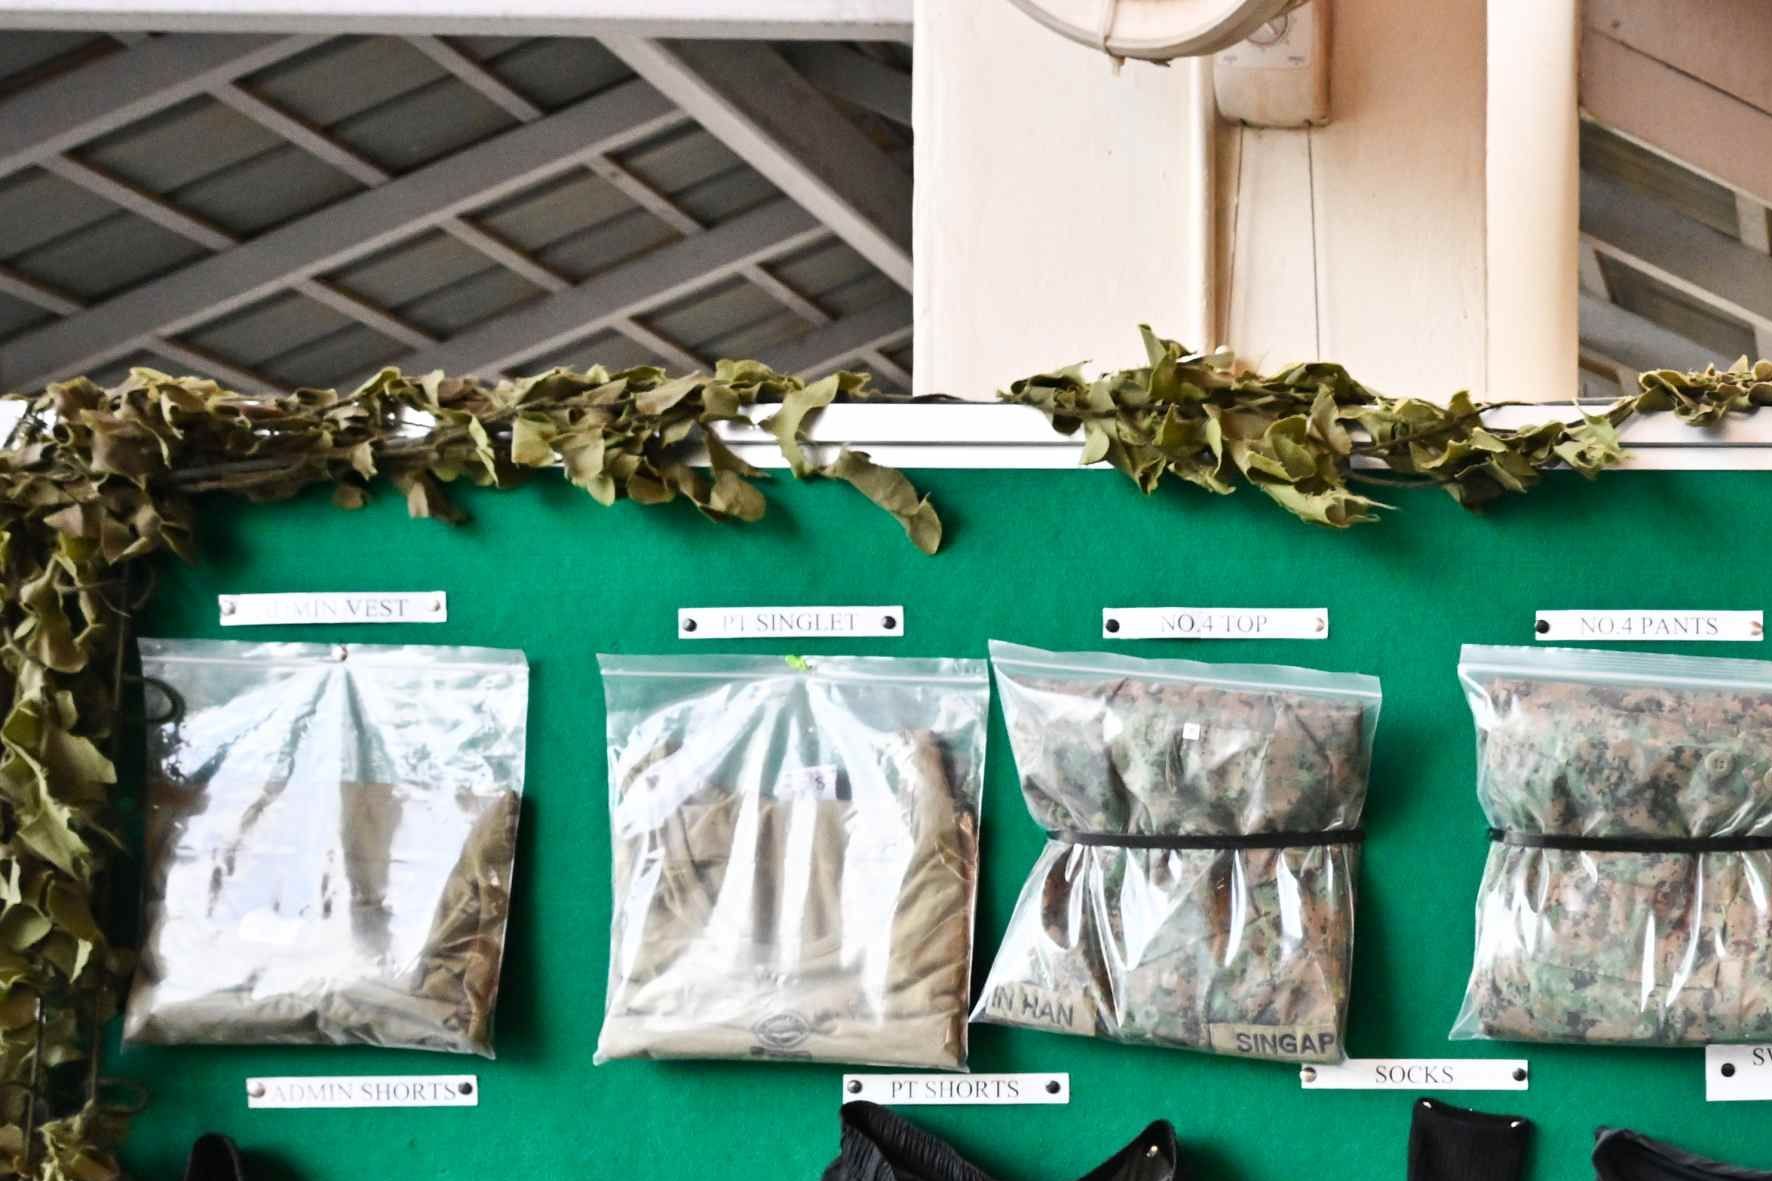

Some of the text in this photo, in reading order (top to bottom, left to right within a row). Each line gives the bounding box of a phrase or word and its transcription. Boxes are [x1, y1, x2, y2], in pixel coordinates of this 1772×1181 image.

[346, 599, 410, 617] VEST
[722, 612, 858, 632] PT SINGLET
[1161, 614, 1268, 633] NO.4 TOP
[1581, 616, 1719, 635] NO.4 PANTS
[1375, 1064, 1455, 1084] SOCKS
[271, 1081, 458, 1102] ADMIN SHORTS
[891, 1080, 1021, 1098] PT SHORTS
